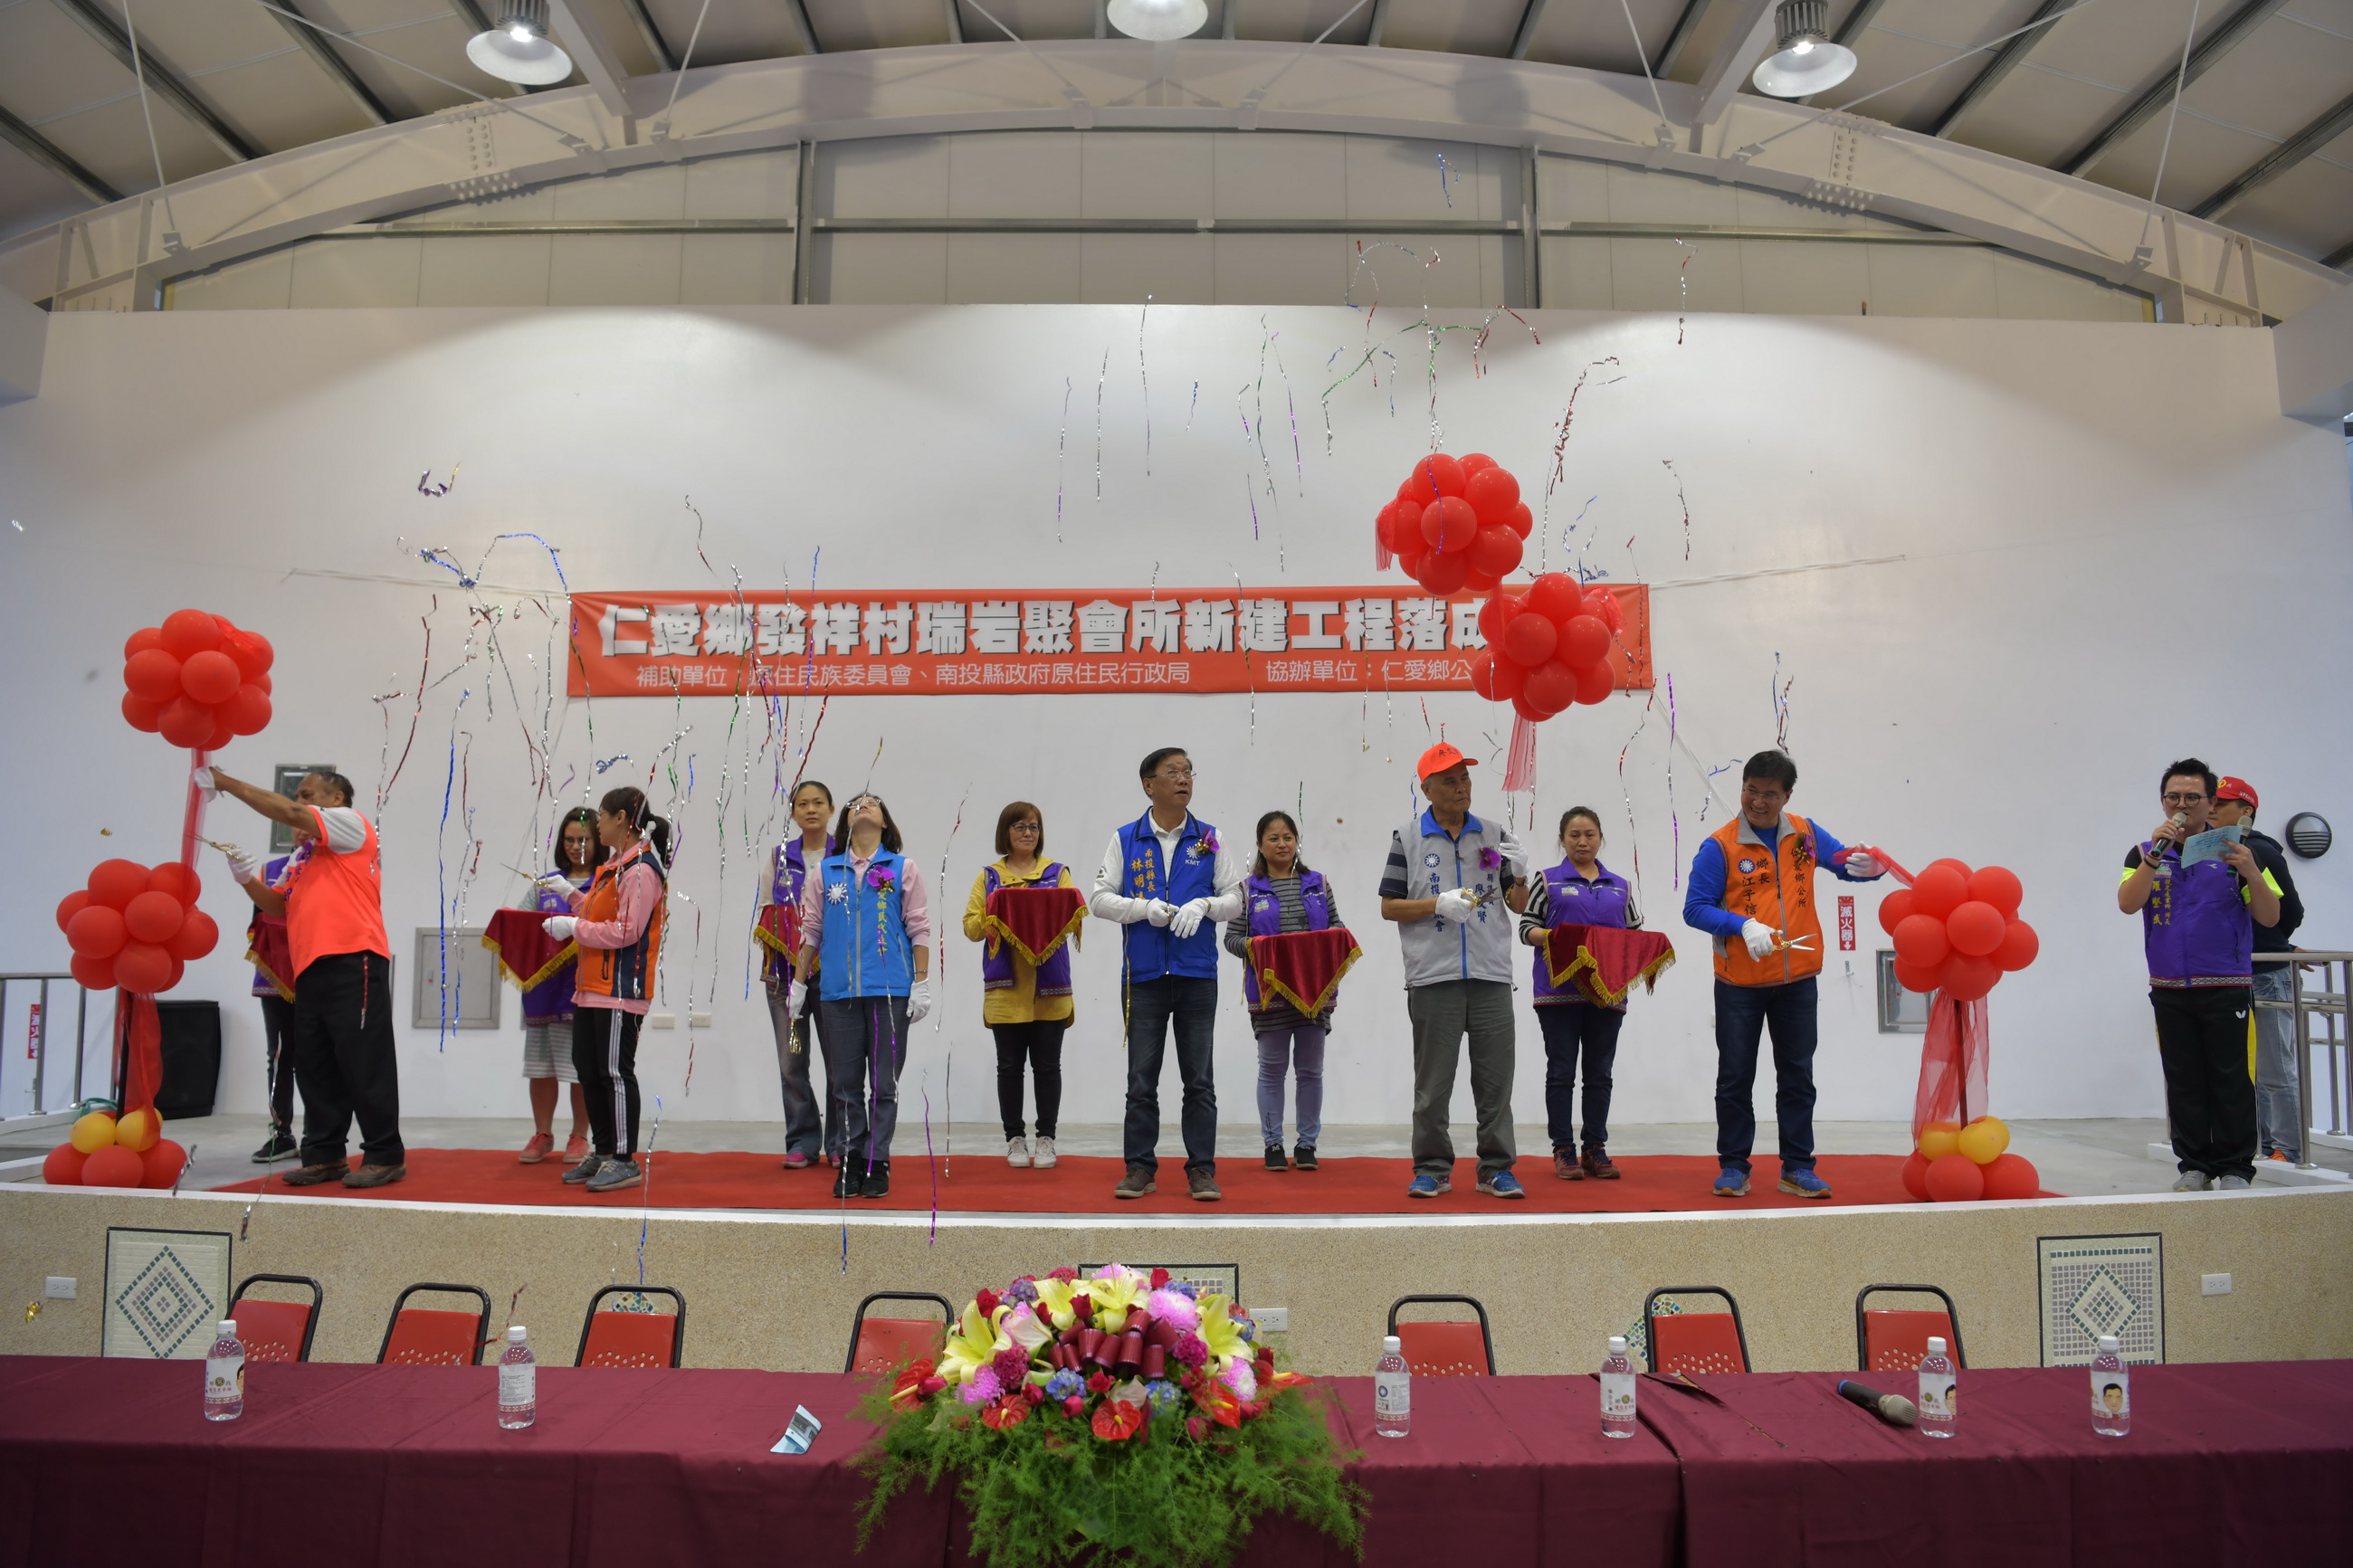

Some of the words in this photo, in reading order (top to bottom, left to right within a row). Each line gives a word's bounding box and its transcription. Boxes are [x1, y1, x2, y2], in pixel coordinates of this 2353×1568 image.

[1145, 849, 1156, 892] 南投縣長
[1756, 858, 1770, 885] 鄉長
[1430, 872, 1445, 932] 南投會
[1741, 876, 1758, 916] 江子信
[1840, 906, 1853, 942] 滅火器
